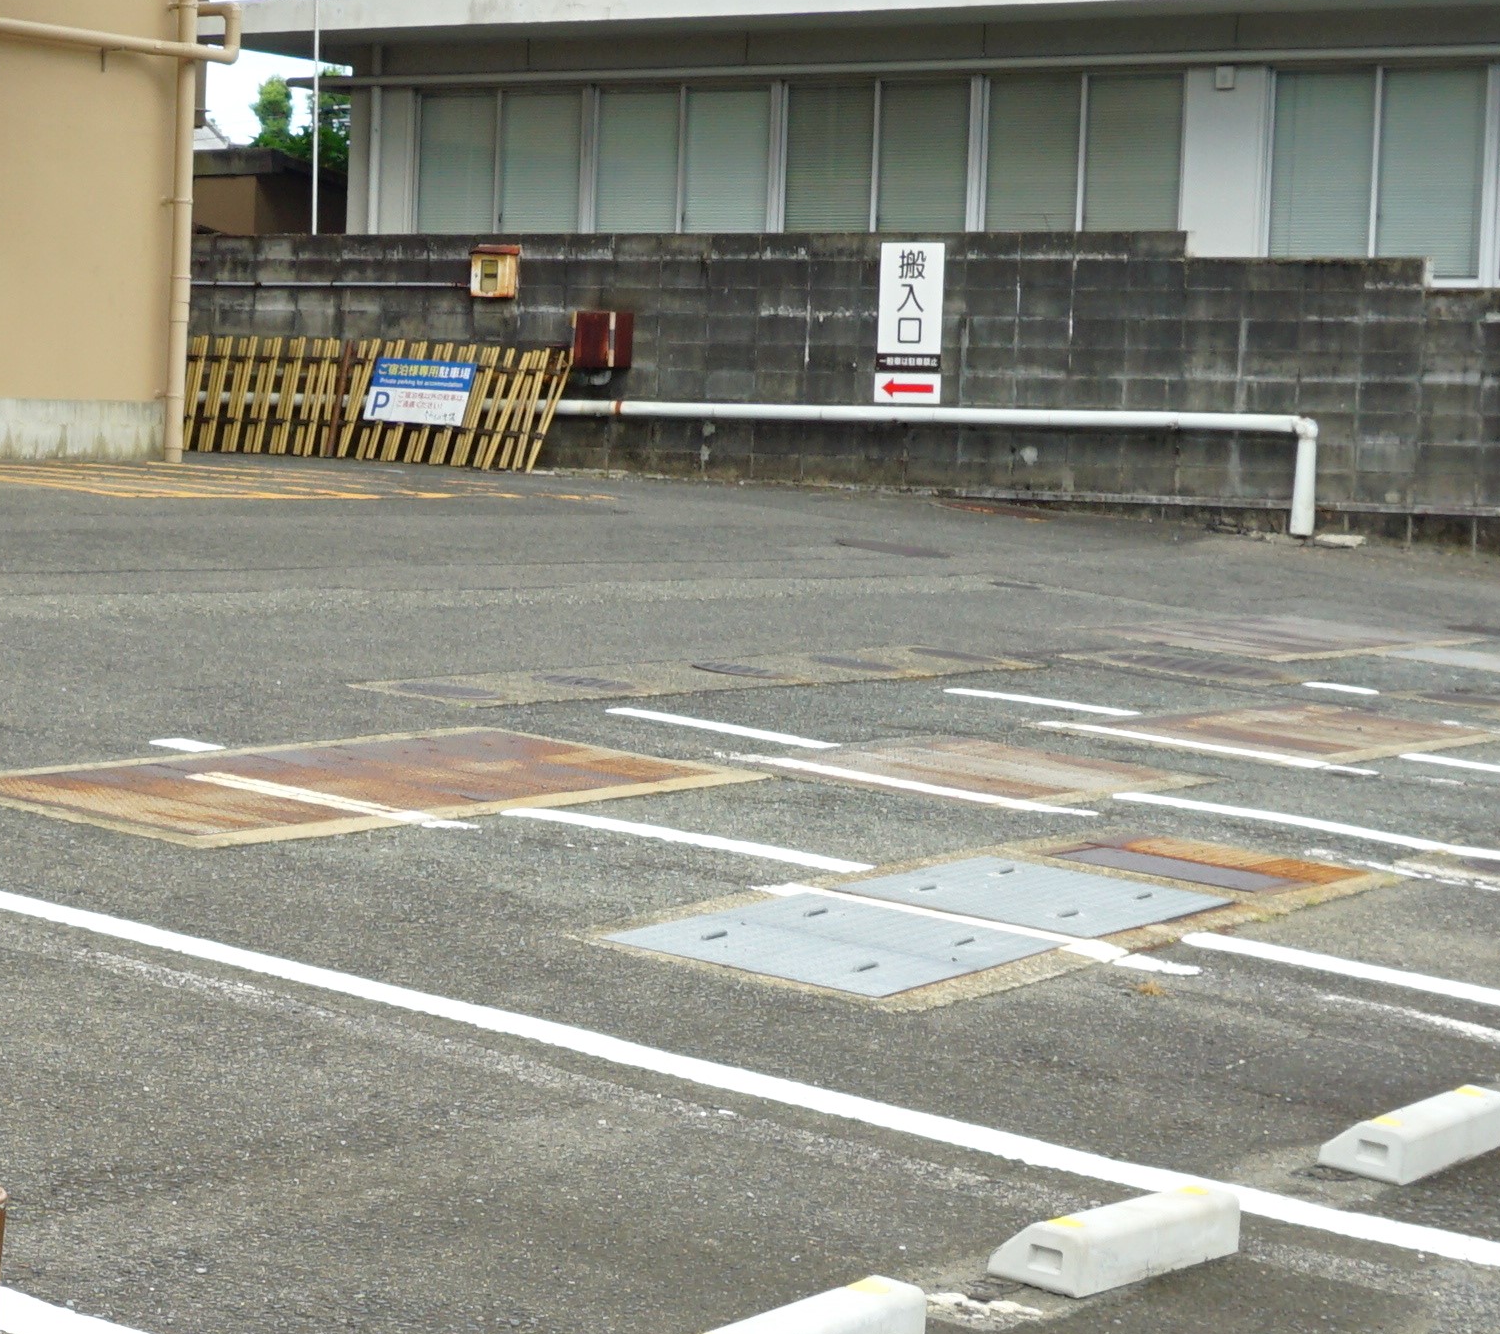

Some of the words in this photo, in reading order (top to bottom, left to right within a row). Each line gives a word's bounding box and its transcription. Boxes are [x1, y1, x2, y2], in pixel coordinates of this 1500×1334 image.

[897, 249, 927, 344] 搬入口
[379, 364, 471, 379] ご宿泊様専用駐車場
[370, 390, 390, 416] P
